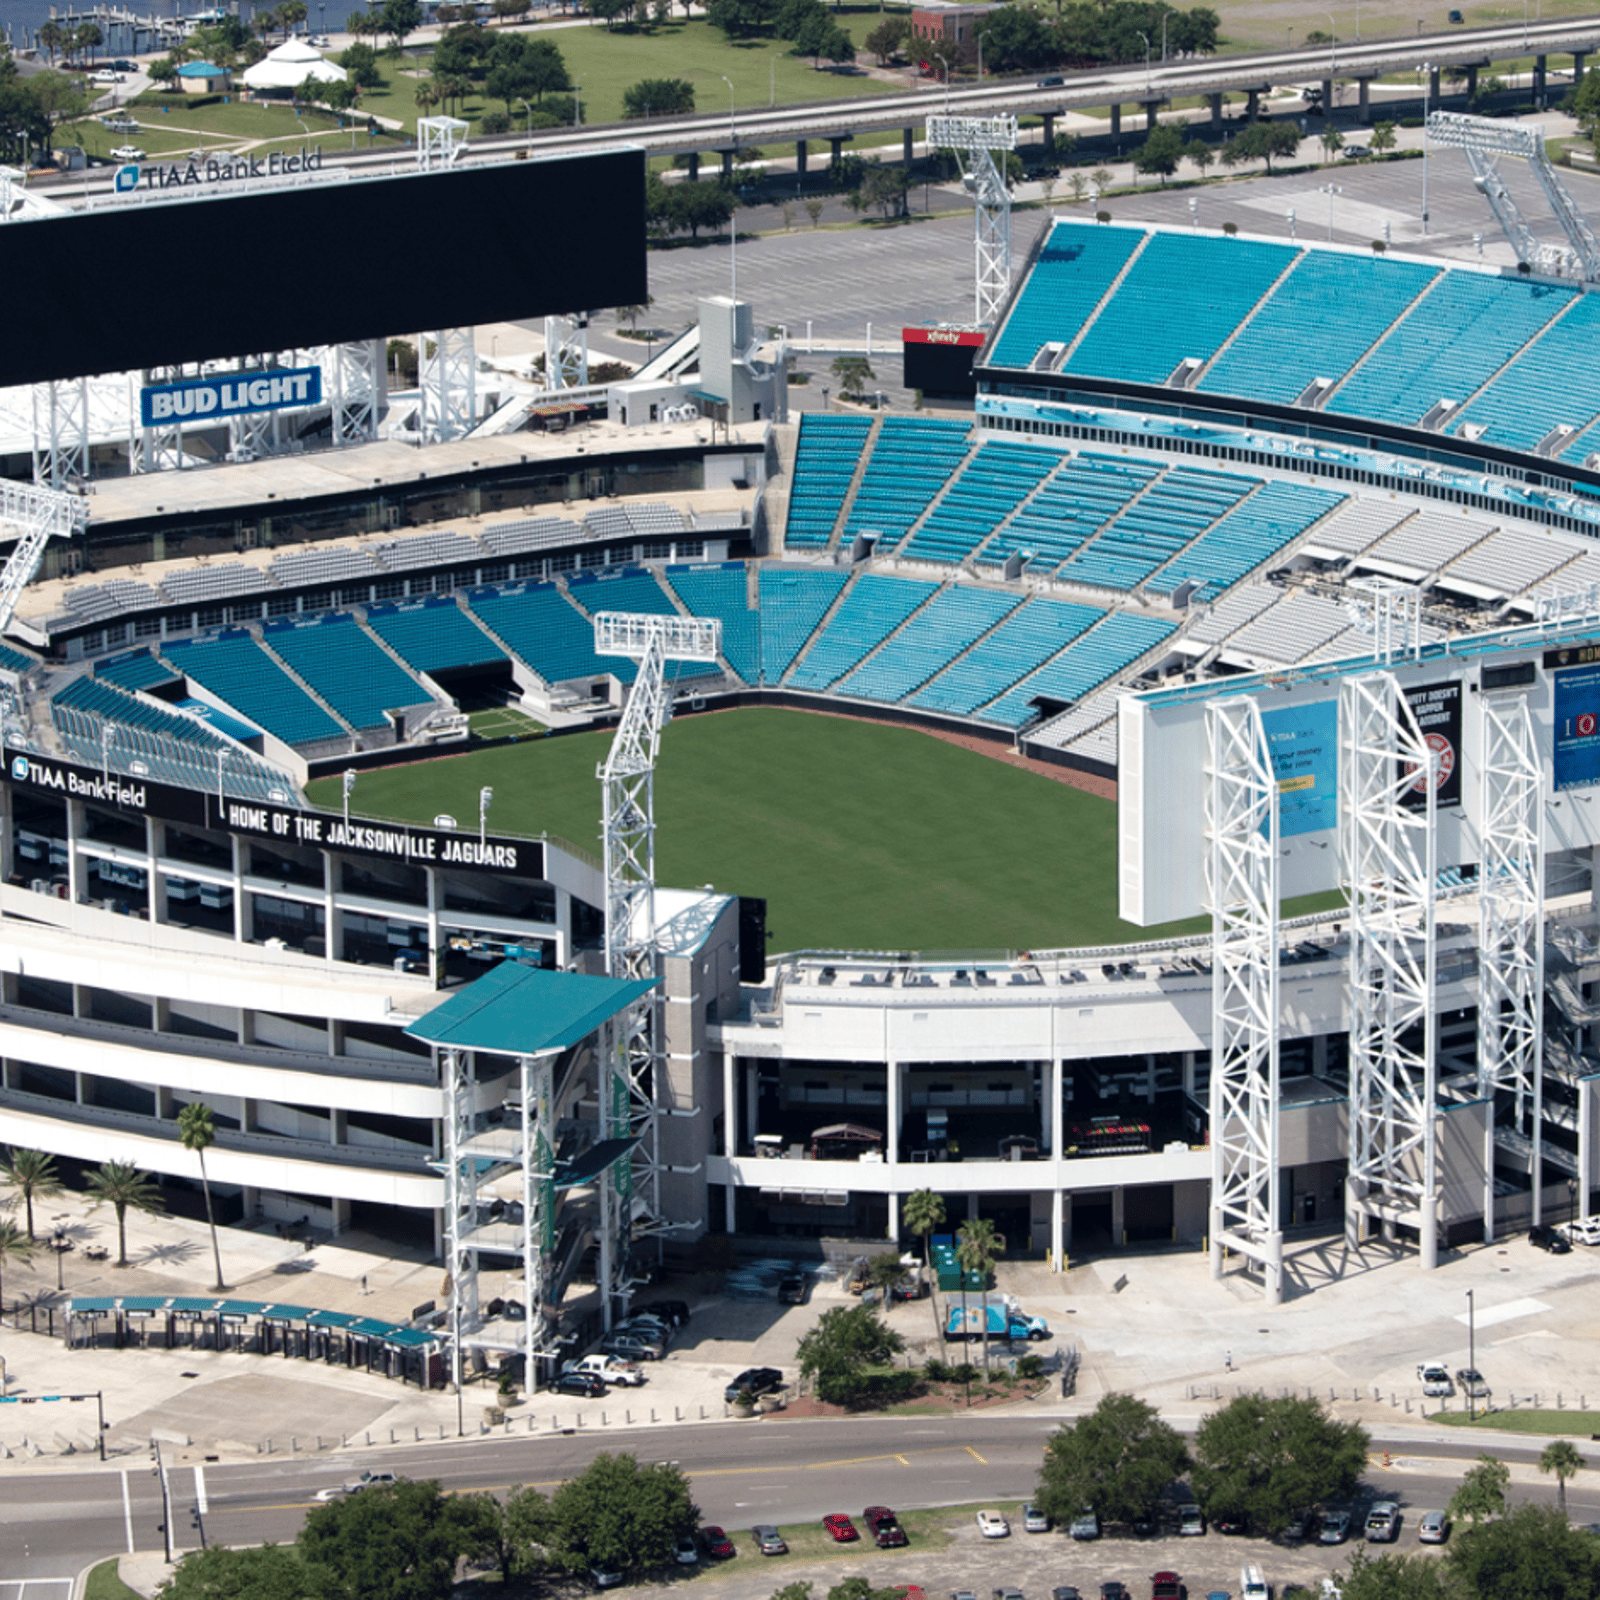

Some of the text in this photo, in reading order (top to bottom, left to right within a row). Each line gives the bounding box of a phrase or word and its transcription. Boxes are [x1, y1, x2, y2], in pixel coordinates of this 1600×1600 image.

[143, 144, 322, 189] TIAA Bank Field
[152, 373, 312, 419] BUD LIGHT
[28, 762, 147, 808] TIAA Bank Field
[229, 804, 517, 868] HOME OF THE JACKSONVILLE JAGUARS
